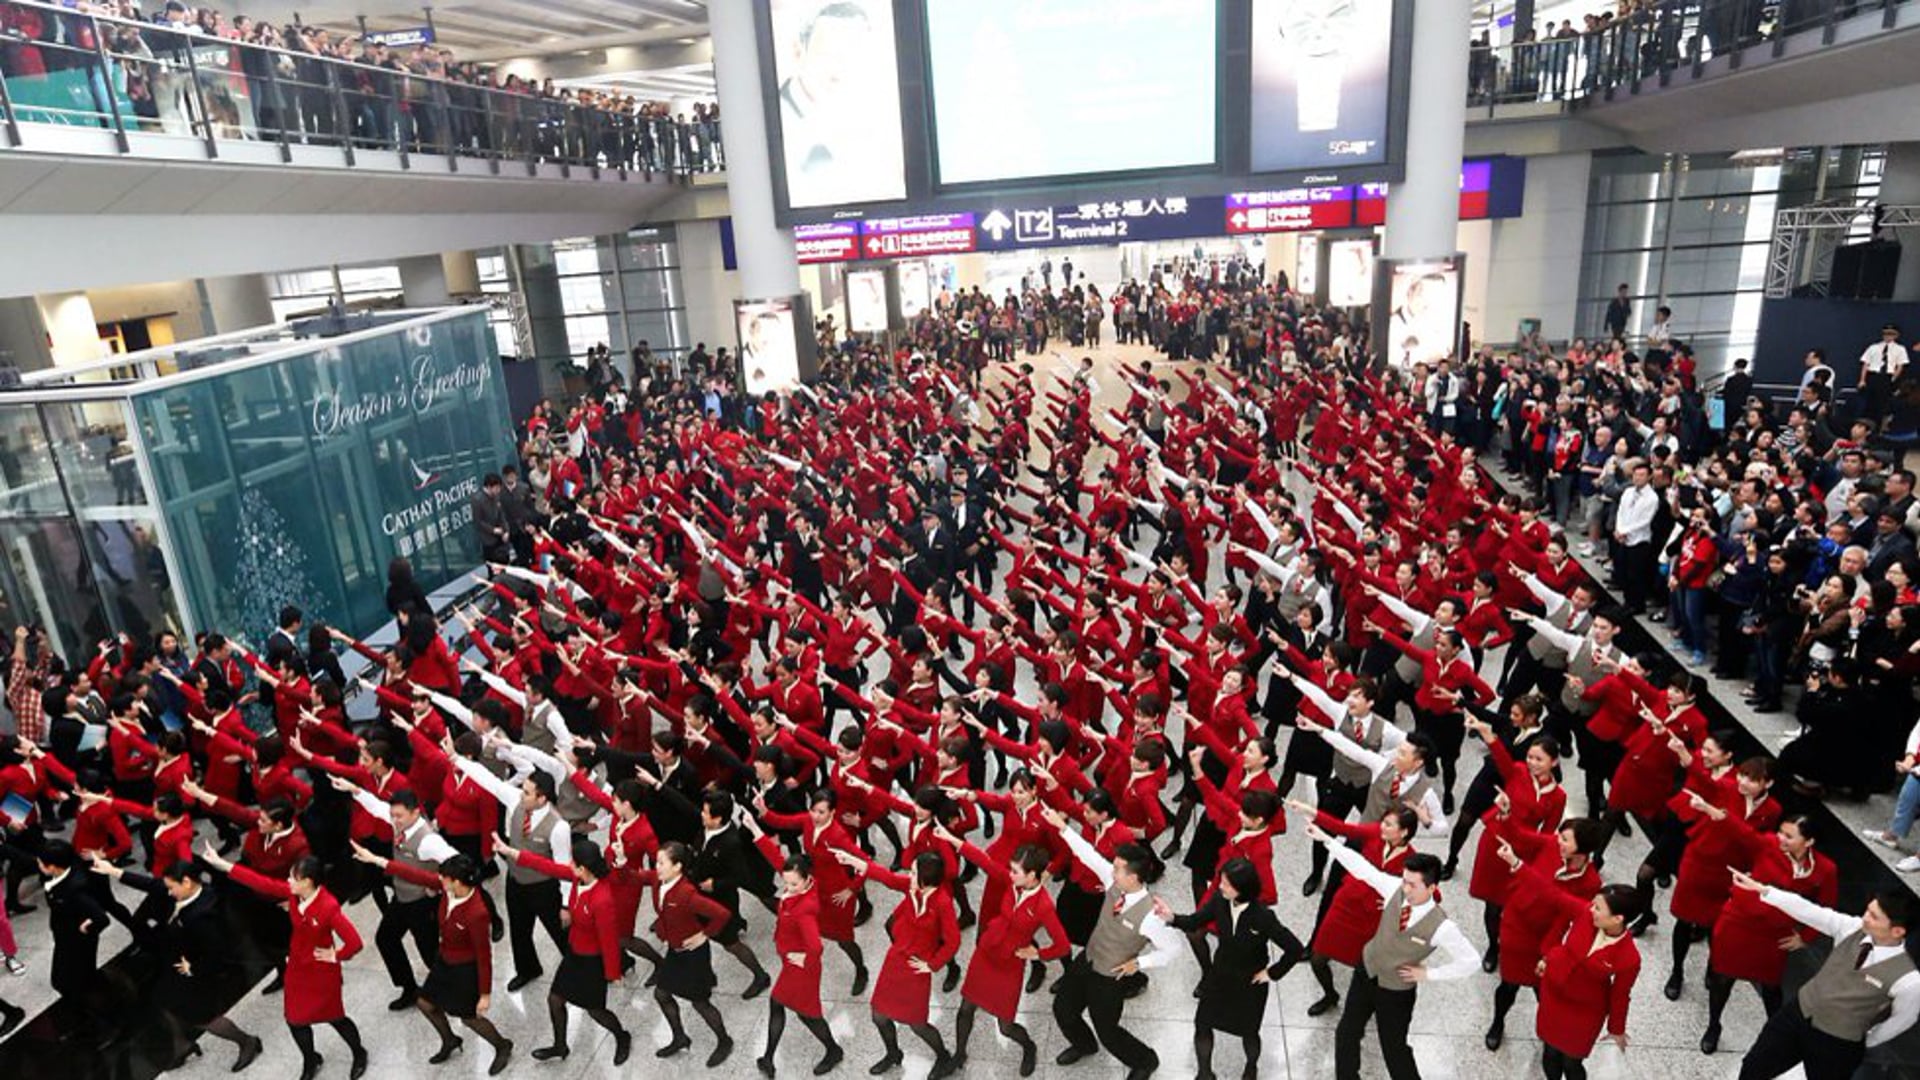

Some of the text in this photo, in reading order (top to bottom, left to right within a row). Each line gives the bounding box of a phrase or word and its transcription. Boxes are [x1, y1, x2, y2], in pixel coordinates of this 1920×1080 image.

[1022, 210, 1050, 233] T2
[1057, 220, 1128, 240] Terminal 2
[312, 354, 492, 437] Season's Greetings
[381, 476, 479, 535] CATHAY PACIFIC
